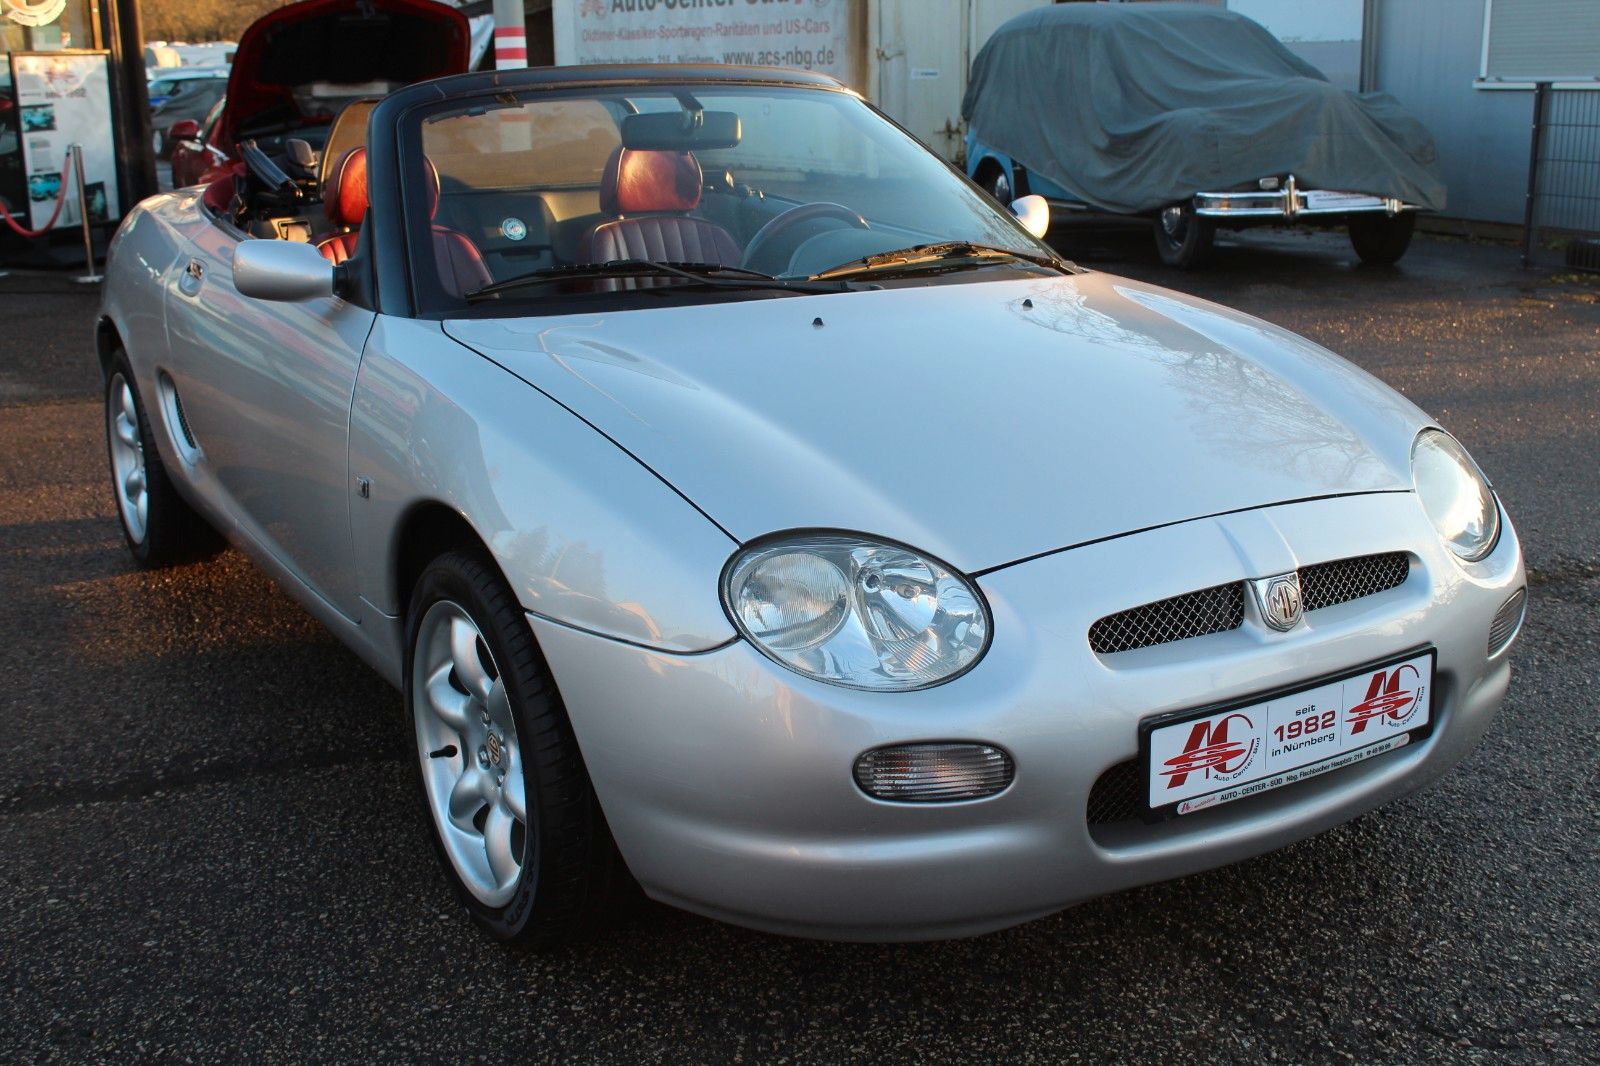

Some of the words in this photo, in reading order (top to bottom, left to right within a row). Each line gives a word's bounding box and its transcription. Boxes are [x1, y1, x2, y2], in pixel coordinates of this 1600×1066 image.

[763, 22, 782, 36] und
[786, 18, 830, 34] US-Cars
[722, 45, 834, 70] www.acs-nbg.de
[1271, 585, 1298, 619] MG
[1295, 704, 1316, 716] seit
[1273, 710, 1336, 742] 1982
[1271, 748, 1281, 758] in
[1283, 732, 1335, 754] Nürnberg
[1219, 791, 1238, 802] AUTO
[1241, 782, 1267, 796] CENTER
[1269, 777, 1283, 788] SÜD
